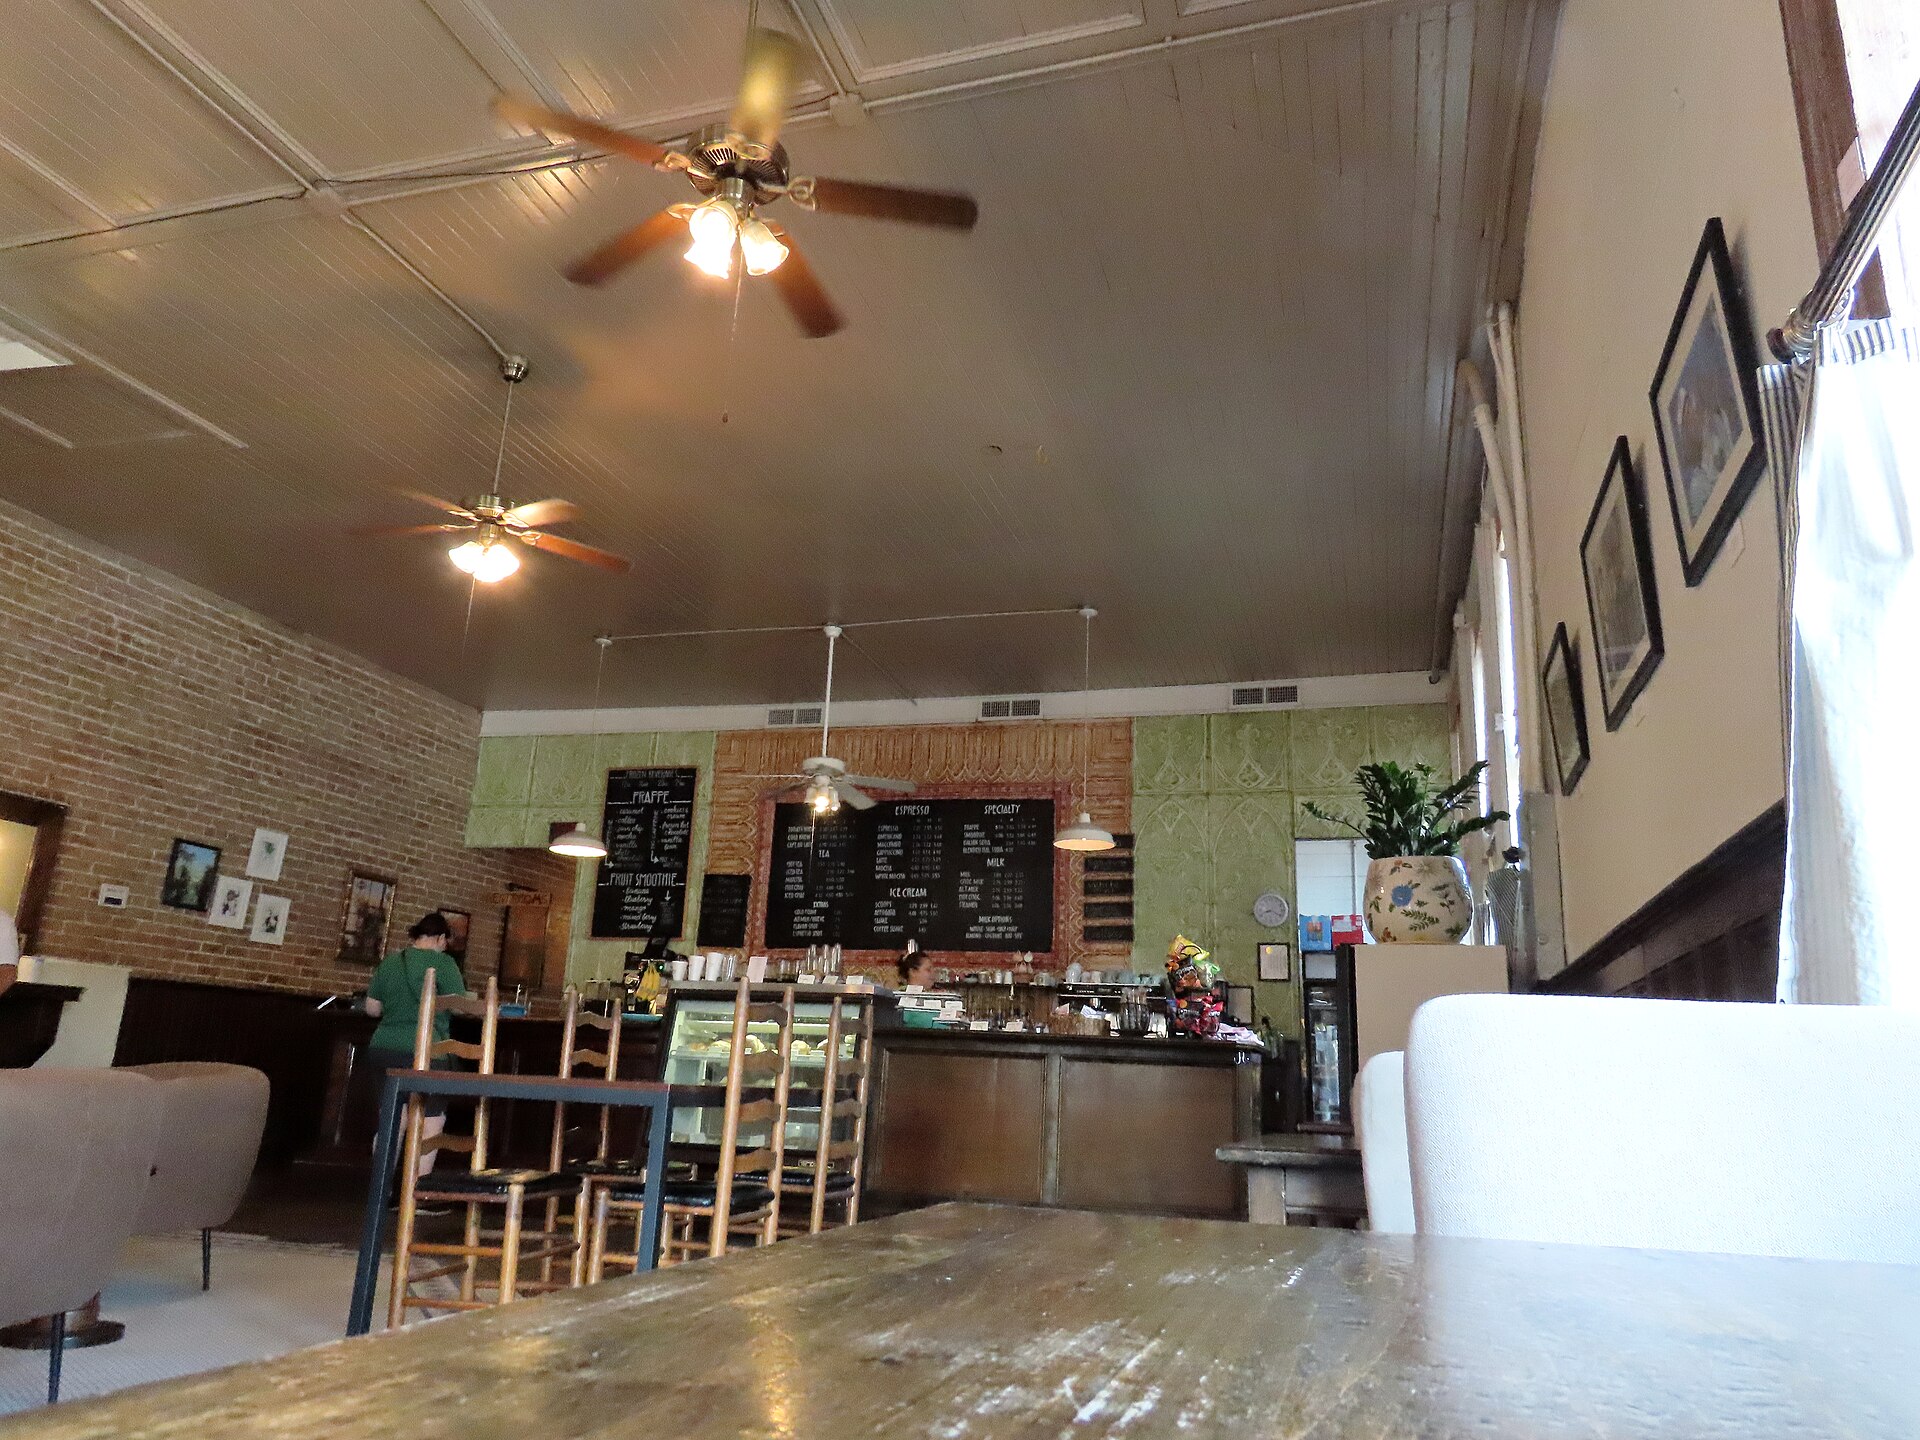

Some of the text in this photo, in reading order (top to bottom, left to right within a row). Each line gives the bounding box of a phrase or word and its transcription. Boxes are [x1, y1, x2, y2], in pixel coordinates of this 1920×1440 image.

[632, 790, 670, 804] FRAPPE
[895, 804, 930, 816] ESPRESSO
[984, 804, 1021, 815] SPECIALTY
[818, 849, 830, 858] TEA
[986, 857, 1005, 867] MILK
[610, 872, 678, 887] FRUIT SMOOTHIE
[889, 887, 927, 898] ICE CREAM
